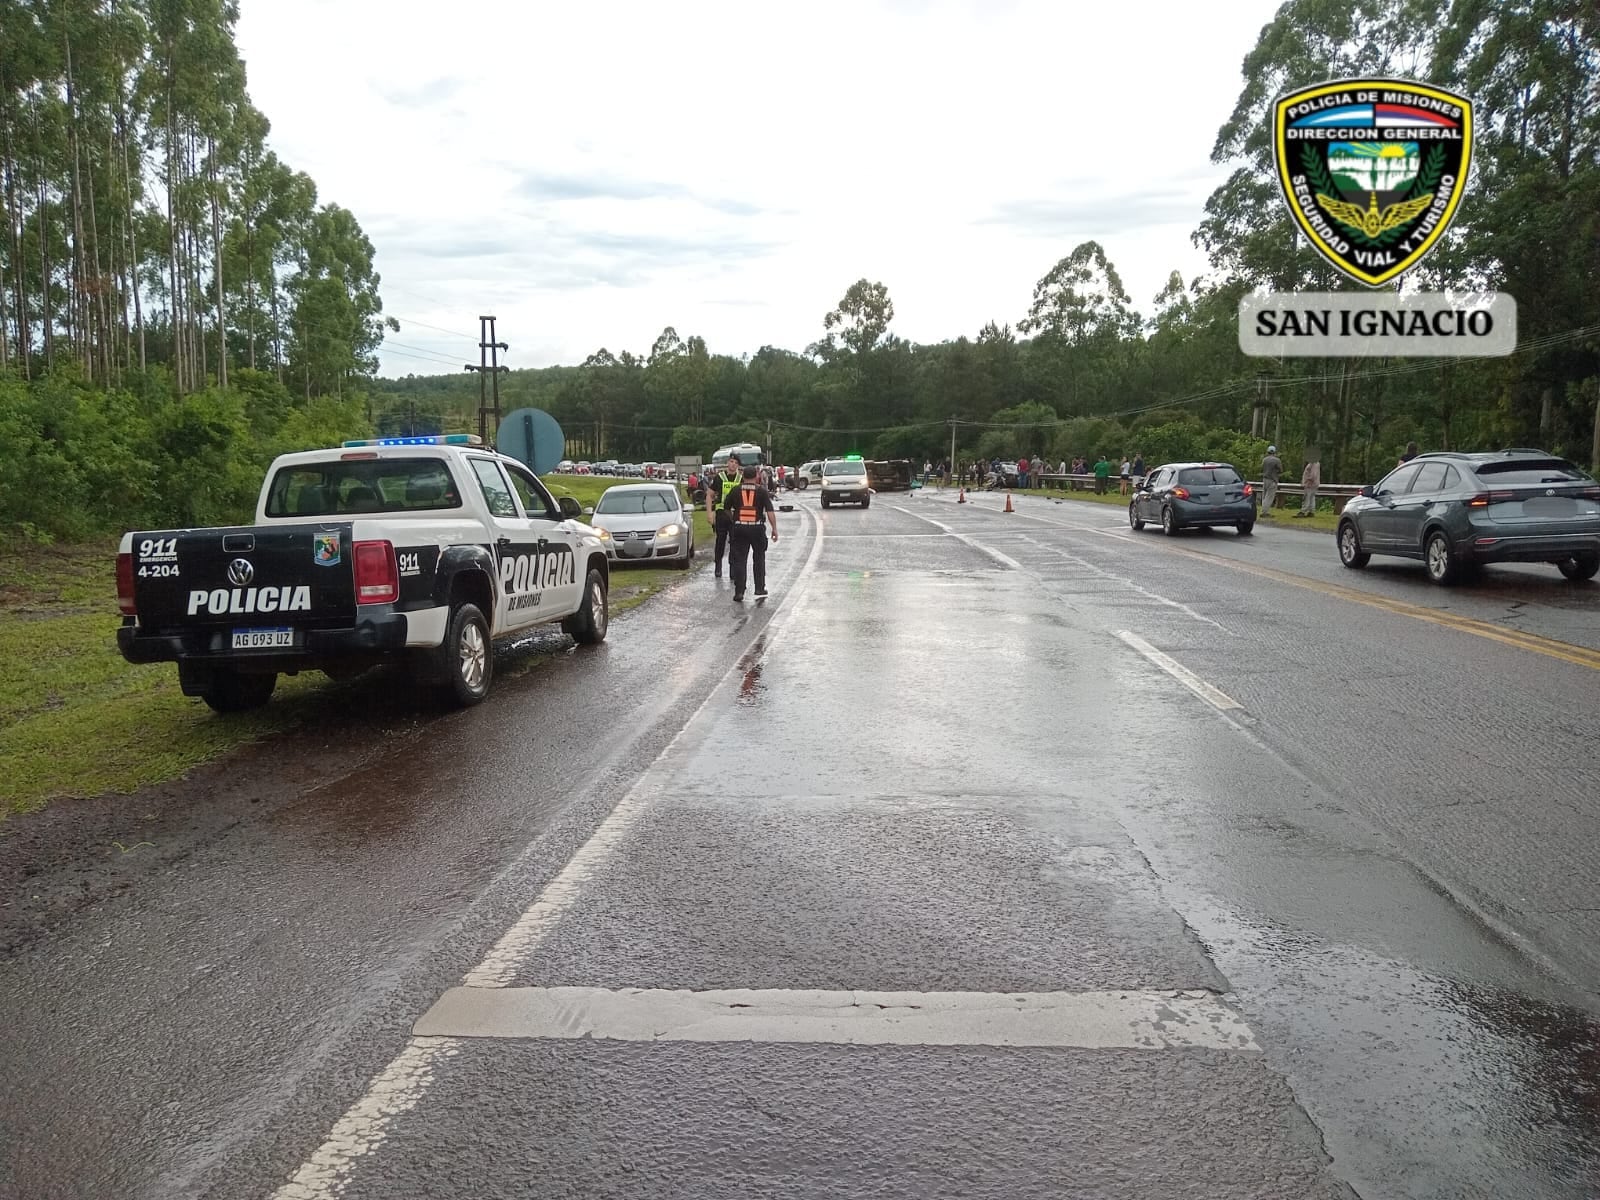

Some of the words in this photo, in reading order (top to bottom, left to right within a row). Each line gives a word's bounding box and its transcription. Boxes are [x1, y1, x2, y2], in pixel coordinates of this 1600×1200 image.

[139, 538, 178, 557] 911
[138, 564, 180, 578] 4-204
[399, 553, 420, 571] 911
[501, 551, 574, 595] POLICIA
[187, 585, 312, 616] POLICIA
[235, 634, 249, 647] AG
[252, 633, 273, 646] 093
[276, 632, 290, 645] UZ
